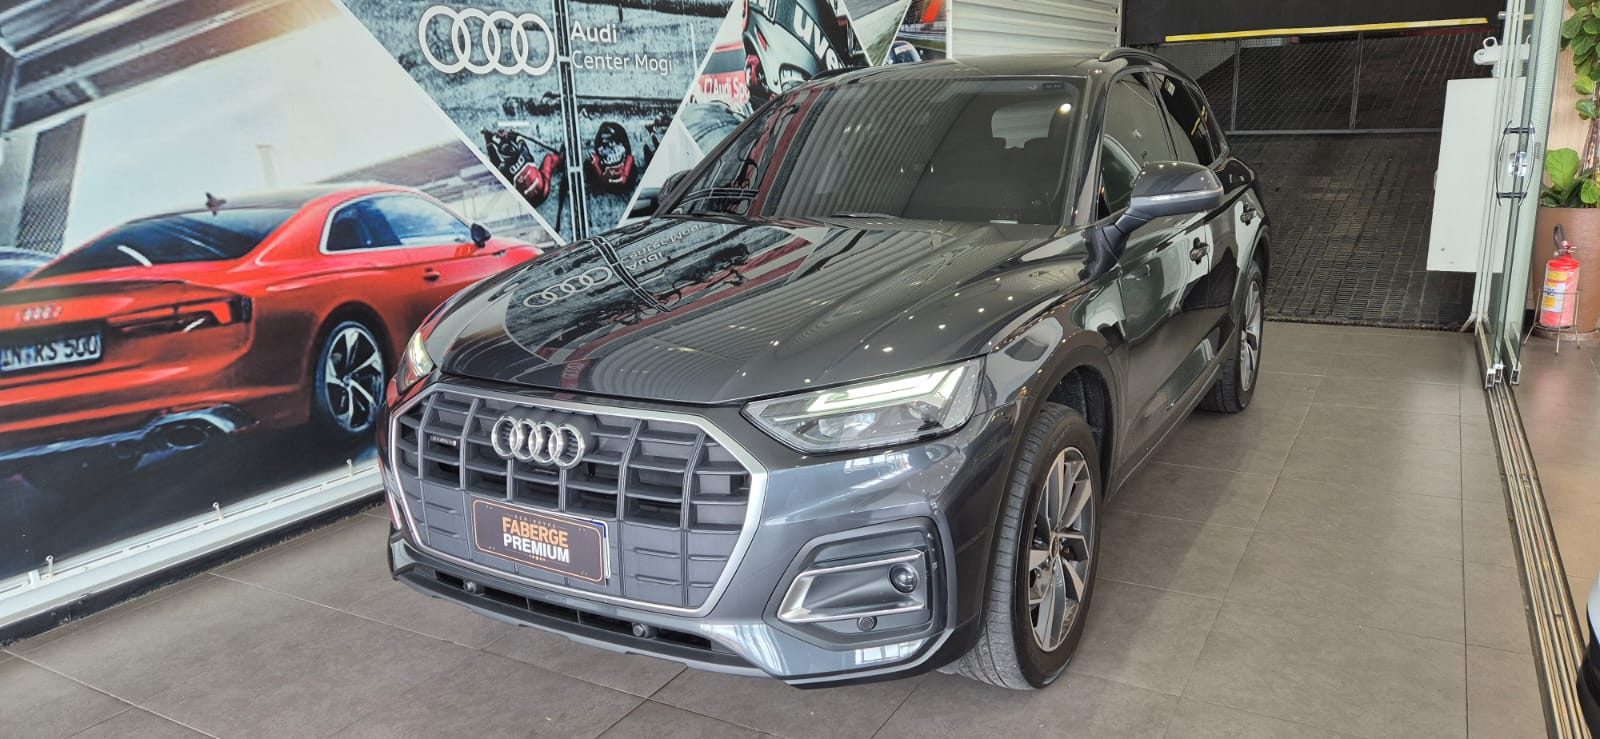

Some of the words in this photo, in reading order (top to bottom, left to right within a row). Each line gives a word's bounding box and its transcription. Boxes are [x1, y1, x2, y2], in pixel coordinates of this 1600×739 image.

[570, 20, 617, 43] Audi
[572, 50, 630, 70] Center
[635, 53, 672, 76] Mogi
[713, 76, 731, 97] Audi
[502, 516, 569, 548] FABERGE
[503, 533, 570, 563] PREMIUM
